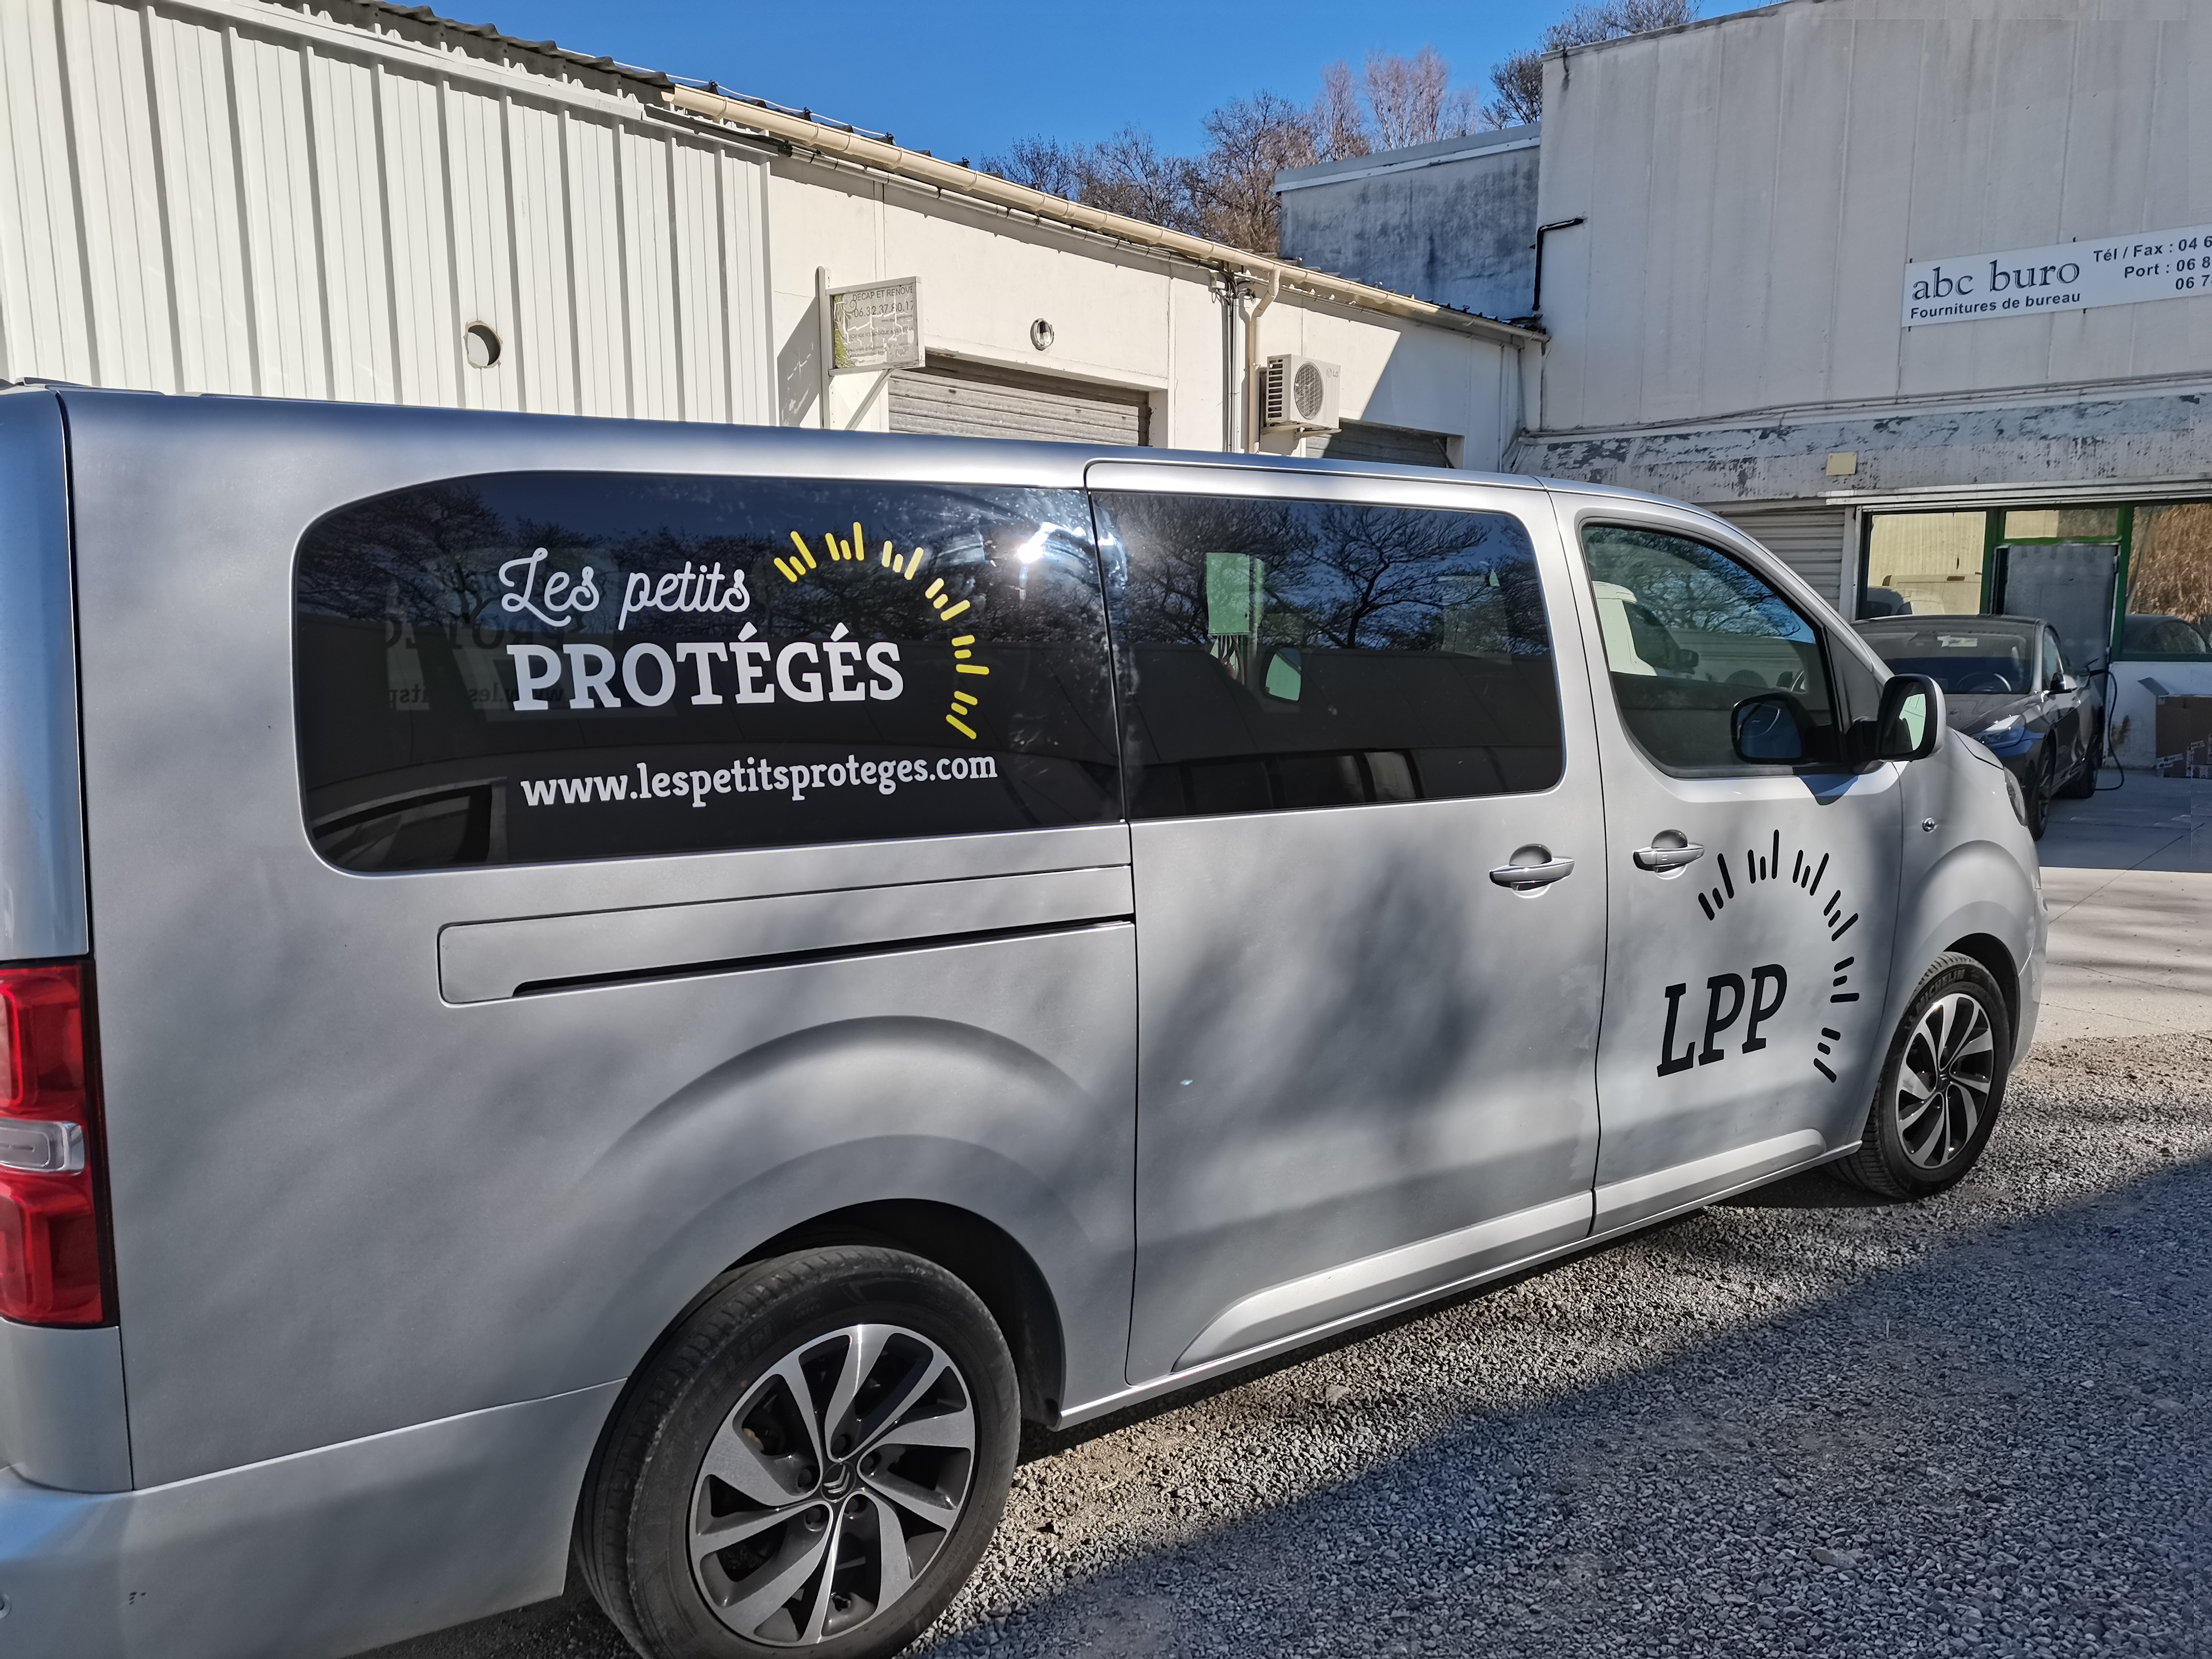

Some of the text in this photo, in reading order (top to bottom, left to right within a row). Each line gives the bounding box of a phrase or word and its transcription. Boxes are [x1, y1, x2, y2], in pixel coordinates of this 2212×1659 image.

[2093, 248, 2117, 262] Tél
[2133, 244, 2164, 257] Fax
[2178, 237, 2198, 251] 04
[1912, 260, 2080, 301] abc buro
[2124, 264, 2160, 278] Port
[2176, 258, 2196, 272] 06
[2176, 276, 2195, 290] 06
[853, 291, 875, 301] DECAP
[877, 289, 885, 298] ET
[1911, 292, 2080, 319] Fournitures de bureau
[499, 548, 750, 630] Les petits
[506, 622, 903, 710] PROTÉGÉS
[520, 755, 998, 808] www.lespetitsproteges.com
[1657, 964, 1787, 1077] LPP
